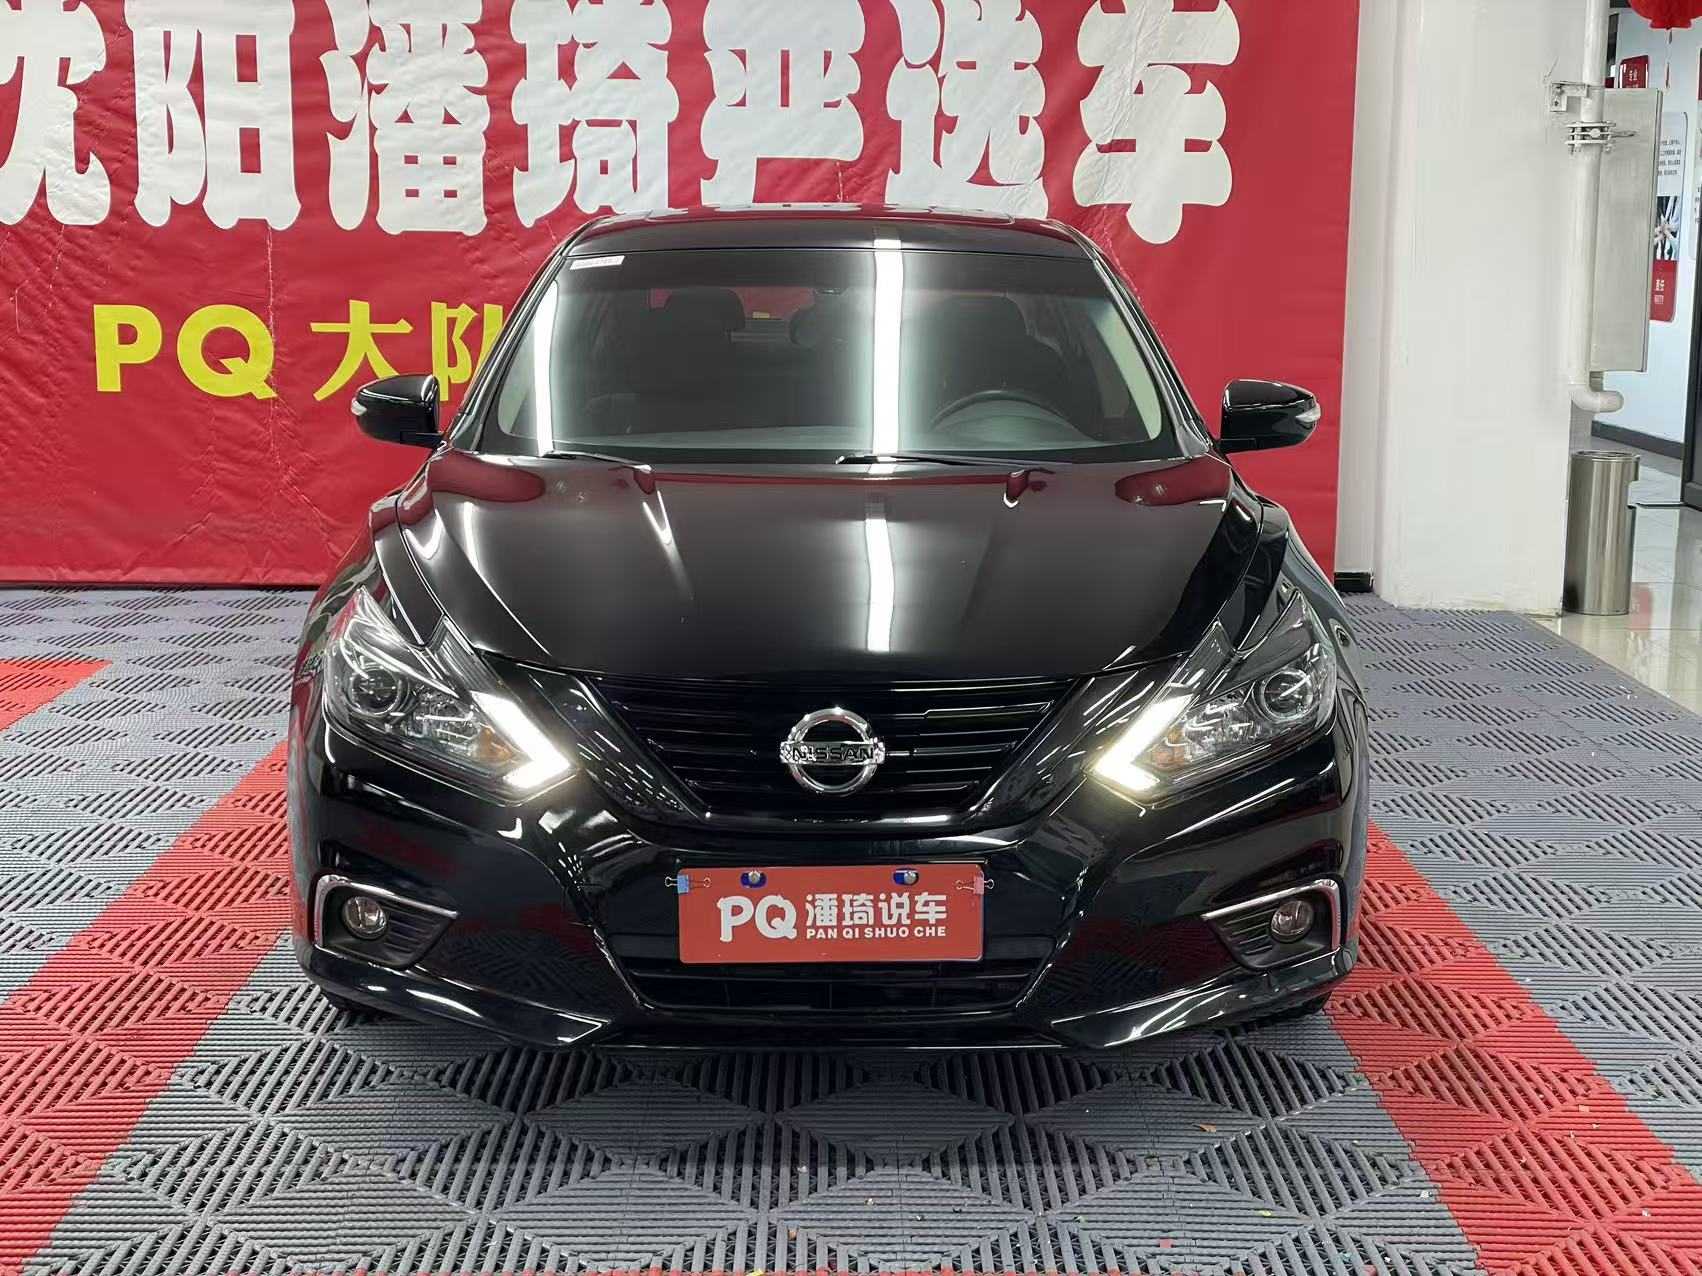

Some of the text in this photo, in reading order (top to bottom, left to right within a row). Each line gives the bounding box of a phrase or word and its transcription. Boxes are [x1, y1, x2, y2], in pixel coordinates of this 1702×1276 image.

[93, 304, 278, 400] PQ
[792, 746, 875, 762] NISSAN
[717, 894, 797, 942] PQ
[805, 892, 947, 926] 潘琦说车
[806, 926, 947, 939] PAN QI SHUO CHE
